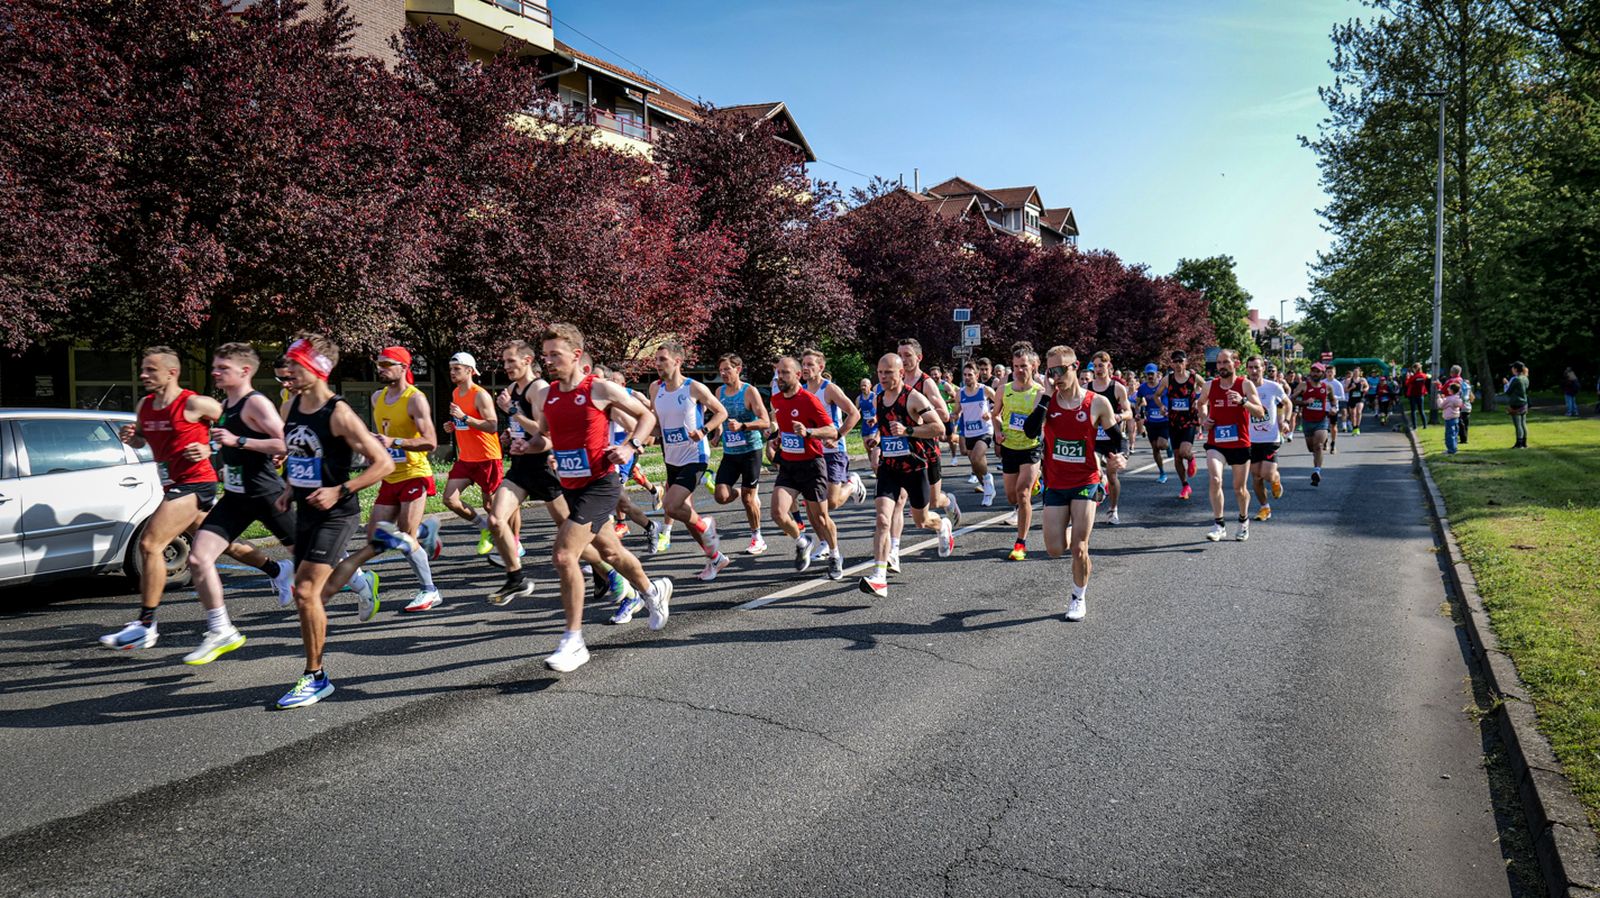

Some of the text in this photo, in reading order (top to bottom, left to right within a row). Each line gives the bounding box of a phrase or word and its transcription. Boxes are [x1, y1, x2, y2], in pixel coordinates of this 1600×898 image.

[667, 432, 685, 443] 428
[727, 433, 742, 442] 336
[1220, 429, 1231, 438] 51
[783, 437, 800, 448] 393
[885, 440, 904, 451] 278
[1055, 444, 1083, 457] 1021
[560, 457, 584, 470] 402
[290, 464, 315, 479] 394
